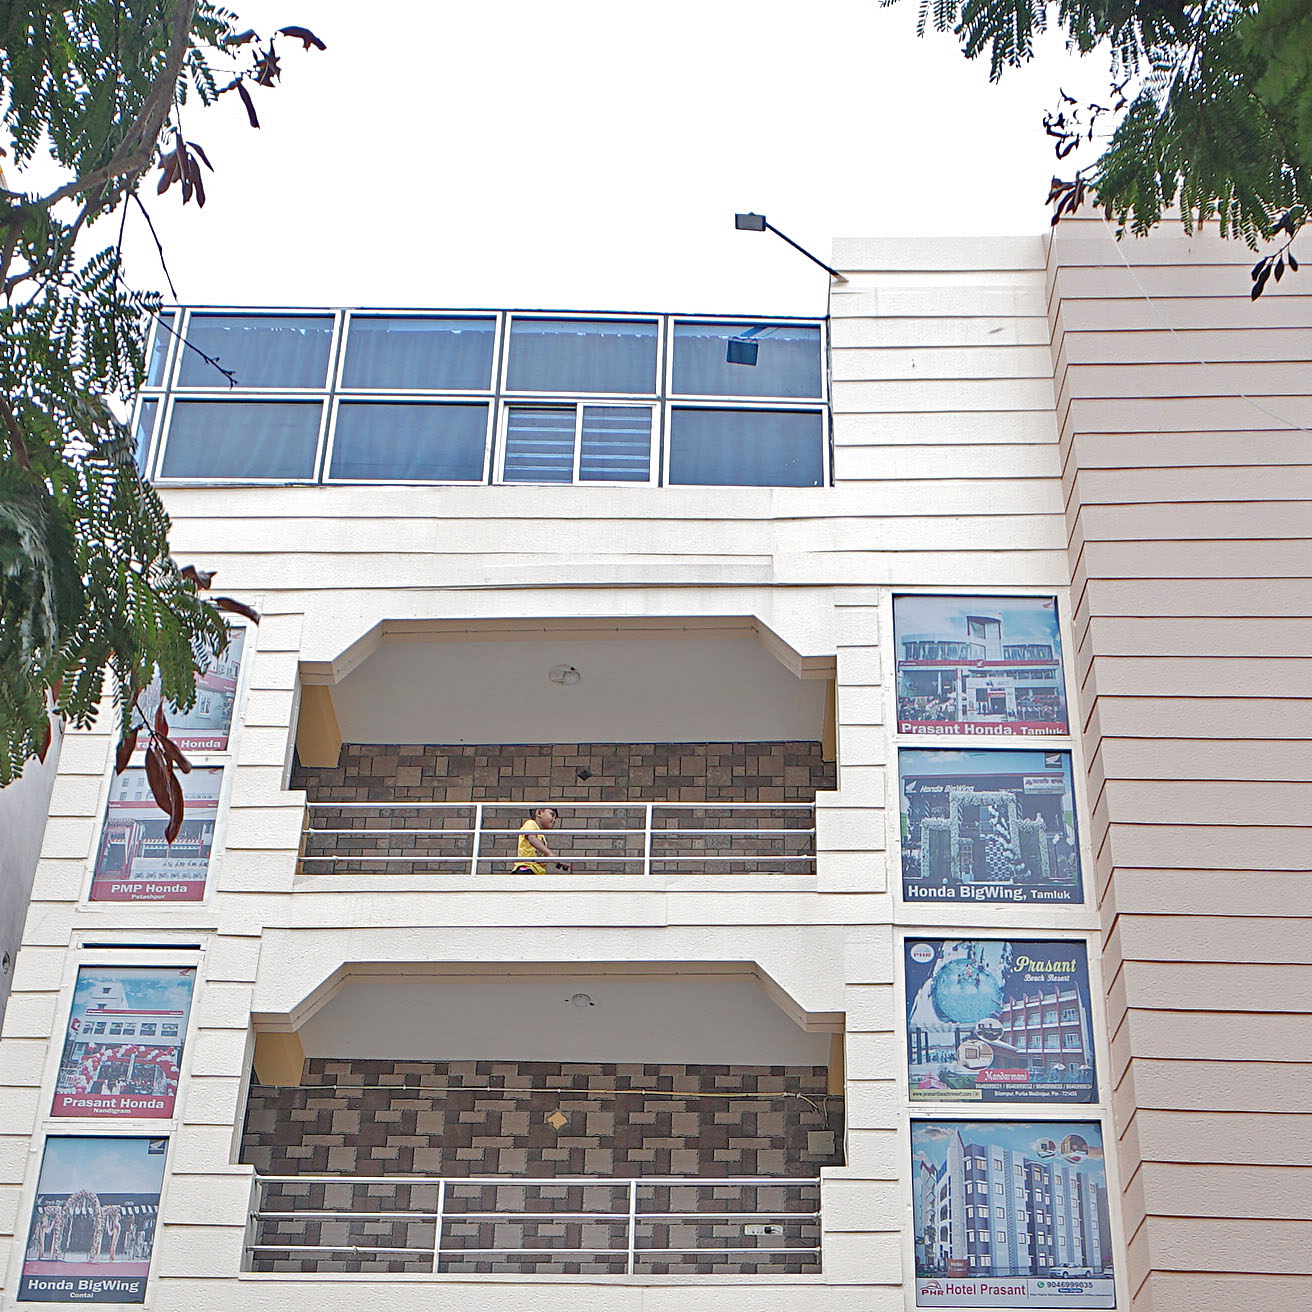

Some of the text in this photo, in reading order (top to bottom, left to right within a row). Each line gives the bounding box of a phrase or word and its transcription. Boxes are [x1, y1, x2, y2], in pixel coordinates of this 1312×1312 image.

[901, 723, 960, 735] Prasant
[1020, 726, 1063, 735] Tamluk
[180, 740, 221, 748] Honda
[111, 884, 188, 893] PMP Honda
[908, 885, 1071, 901] Honda BigWing, Tamluk
[1013, 955, 1077, 973] Prasant
[1023, 974, 1071, 982] Beach Resort
[984, 1070, 1028, 1081] Mandarmani
[63, 1097, 165, 1109] Prasant Honda
[28, 1279, 140, 1293] Honda BigWing
[946, 1283, 1026, 1296] Hotel Prasant
